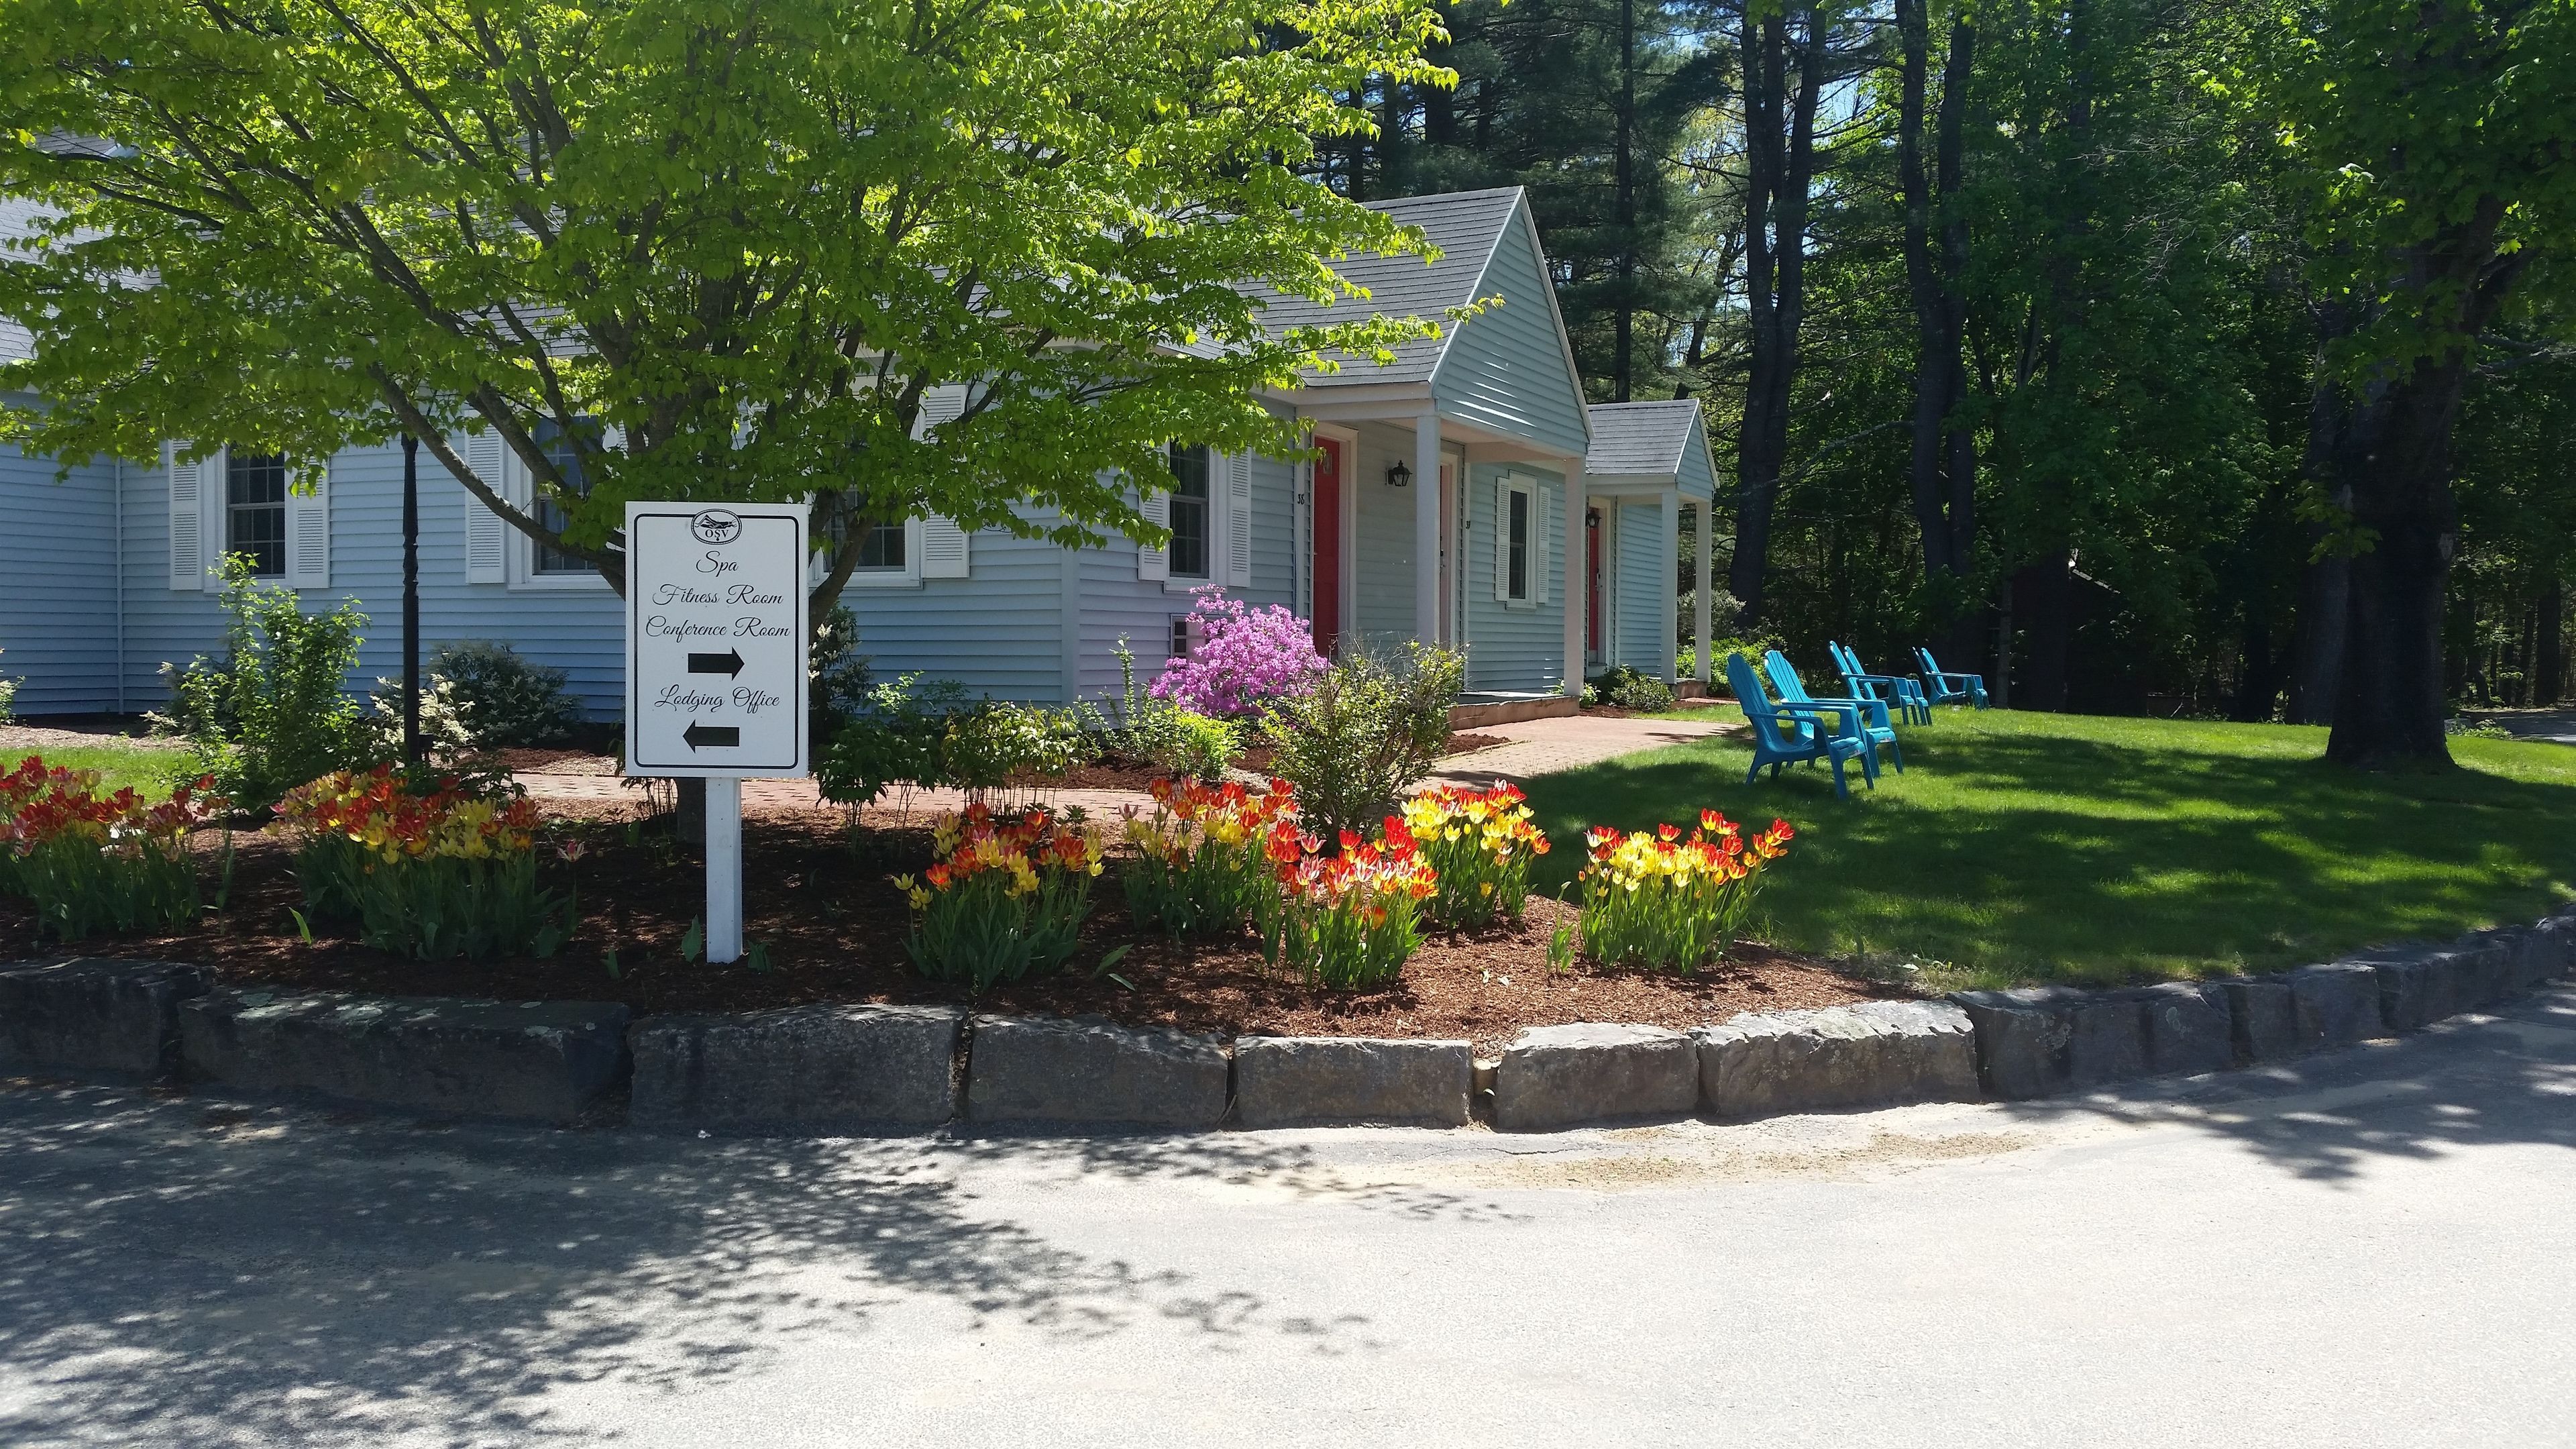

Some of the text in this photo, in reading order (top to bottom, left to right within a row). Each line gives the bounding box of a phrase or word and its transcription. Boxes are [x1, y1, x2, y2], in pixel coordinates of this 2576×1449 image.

[1297, 493, 1304, 504] 38
[705, 529, 729, 539] OSV
[696, 550, 739, 578] Spa
[652, 584, 784, 606] Fitness Room
[645, 615, 790, 643] Conference Room
[654, 684, 780, 714] Lodging Office
